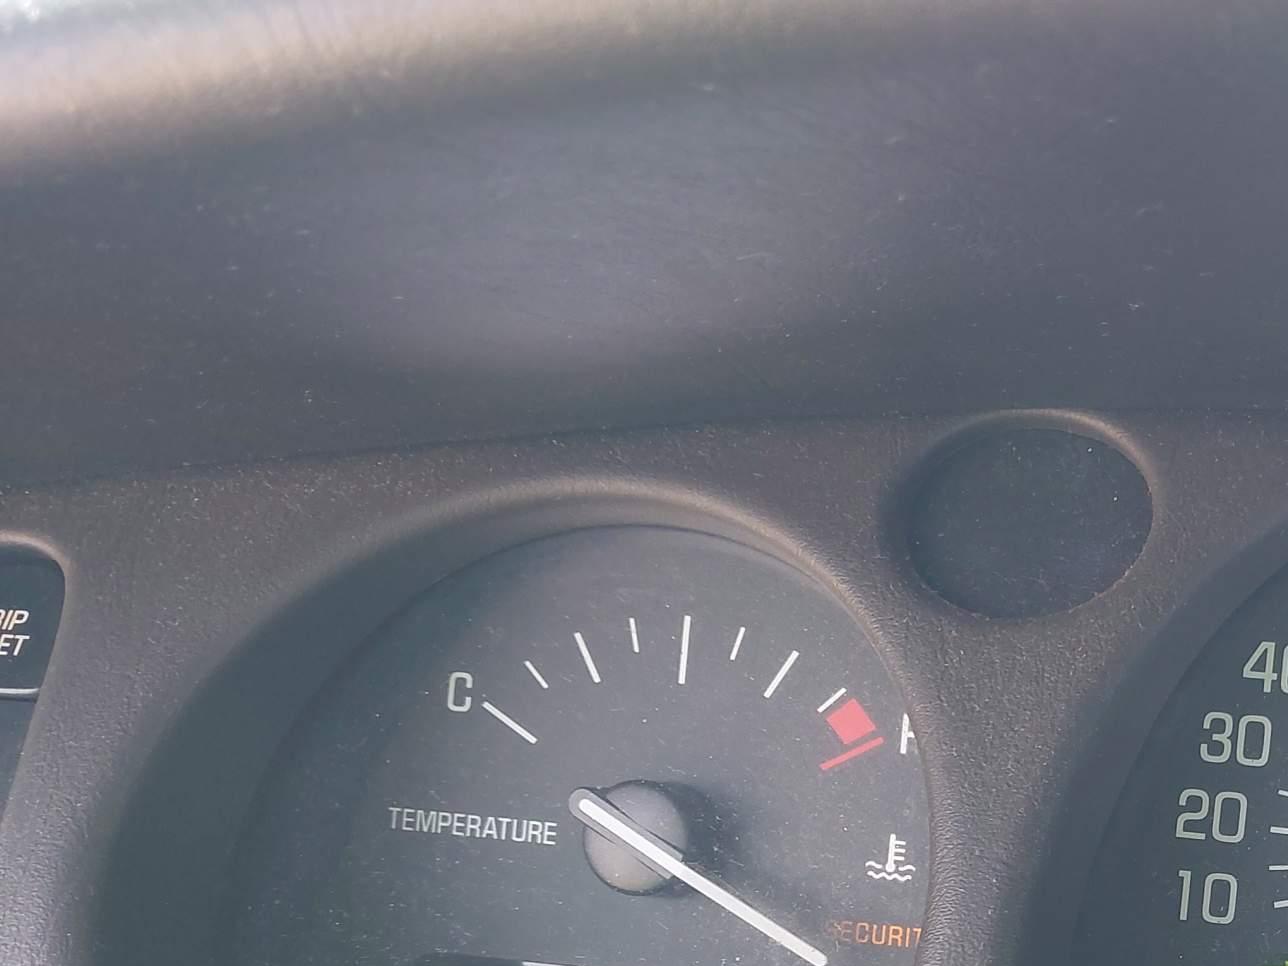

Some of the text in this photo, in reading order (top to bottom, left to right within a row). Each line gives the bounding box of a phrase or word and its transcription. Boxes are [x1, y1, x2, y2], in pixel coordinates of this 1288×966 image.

[447, 671, 473, 712] C
[1200, 711, 1272, 767] 30
[388, 807, 558, 845] TEMPERATURE
[1175, 788, 1248, 843] 20
[1178, 869, 1238, 925] 10
